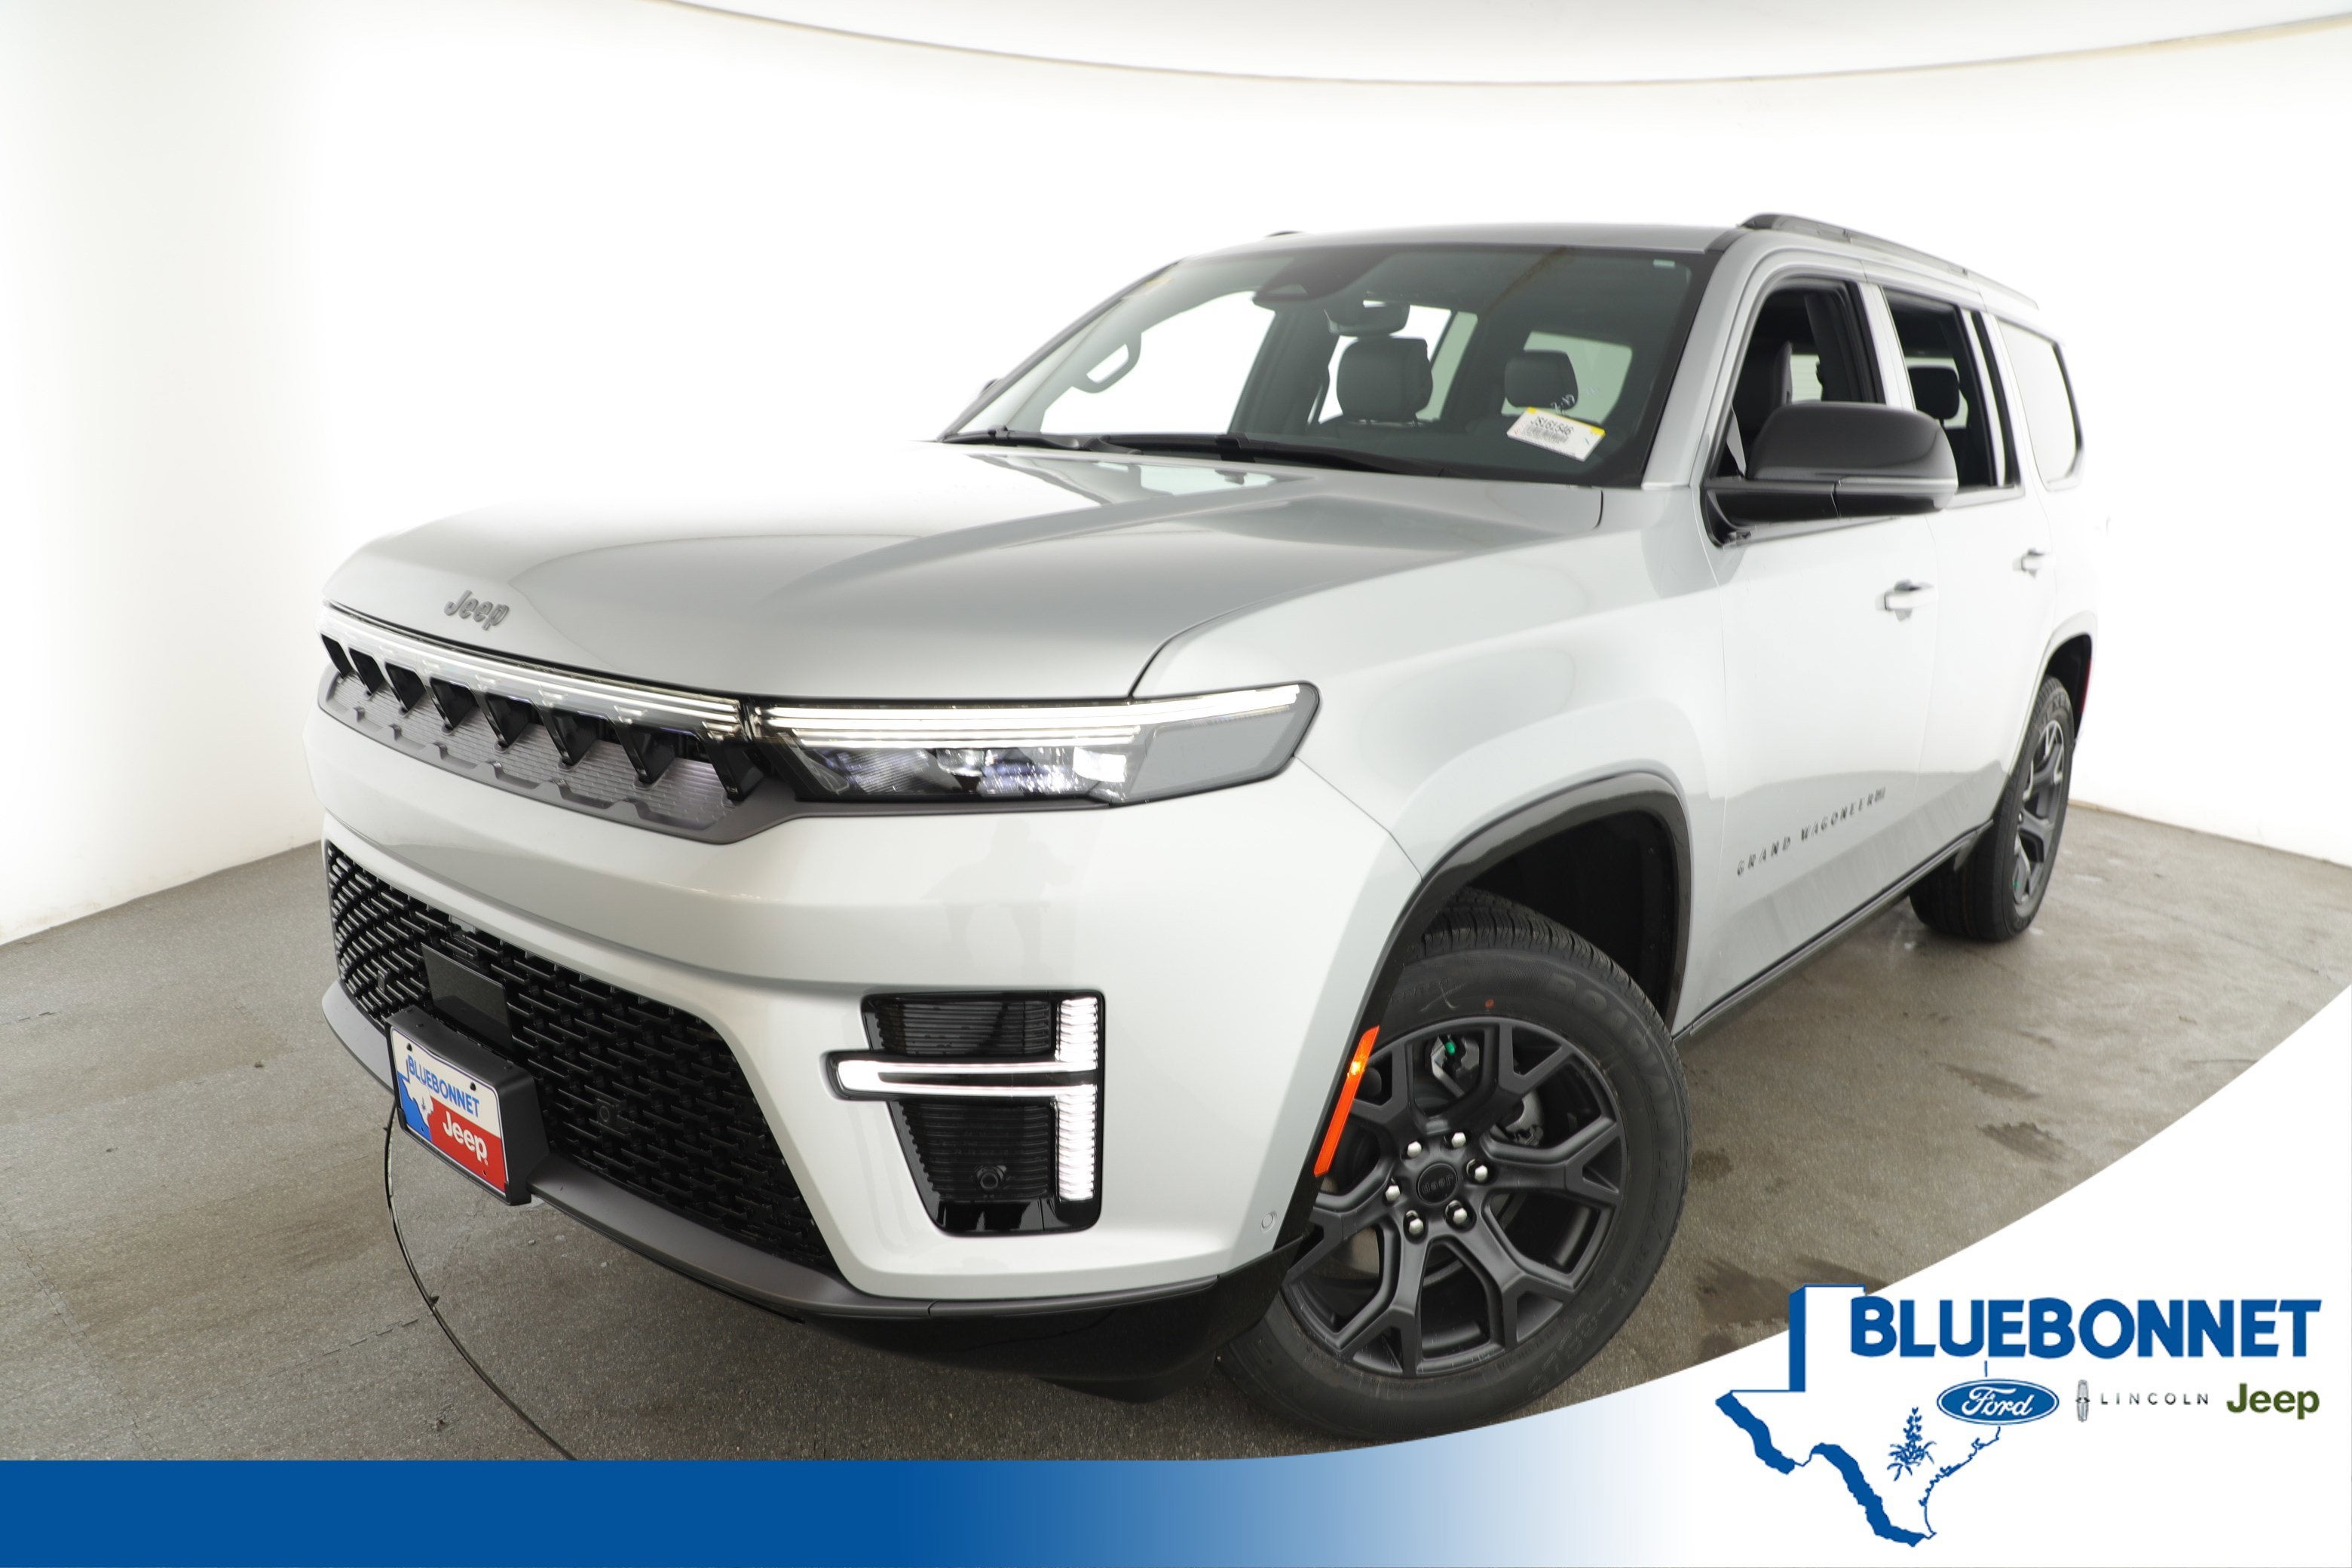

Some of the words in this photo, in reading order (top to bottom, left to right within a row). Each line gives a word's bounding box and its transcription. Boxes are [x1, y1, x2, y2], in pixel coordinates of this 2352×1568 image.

[443, 590, 510, 631] Jeep
[1736, 835, 1791, 877] GRAND
[1801, 792, 1874, 842] WAGONEER
[407, 1055, 480, 1119] BLUEBONNET
[442, 1110, 488, 1163] Jeep
